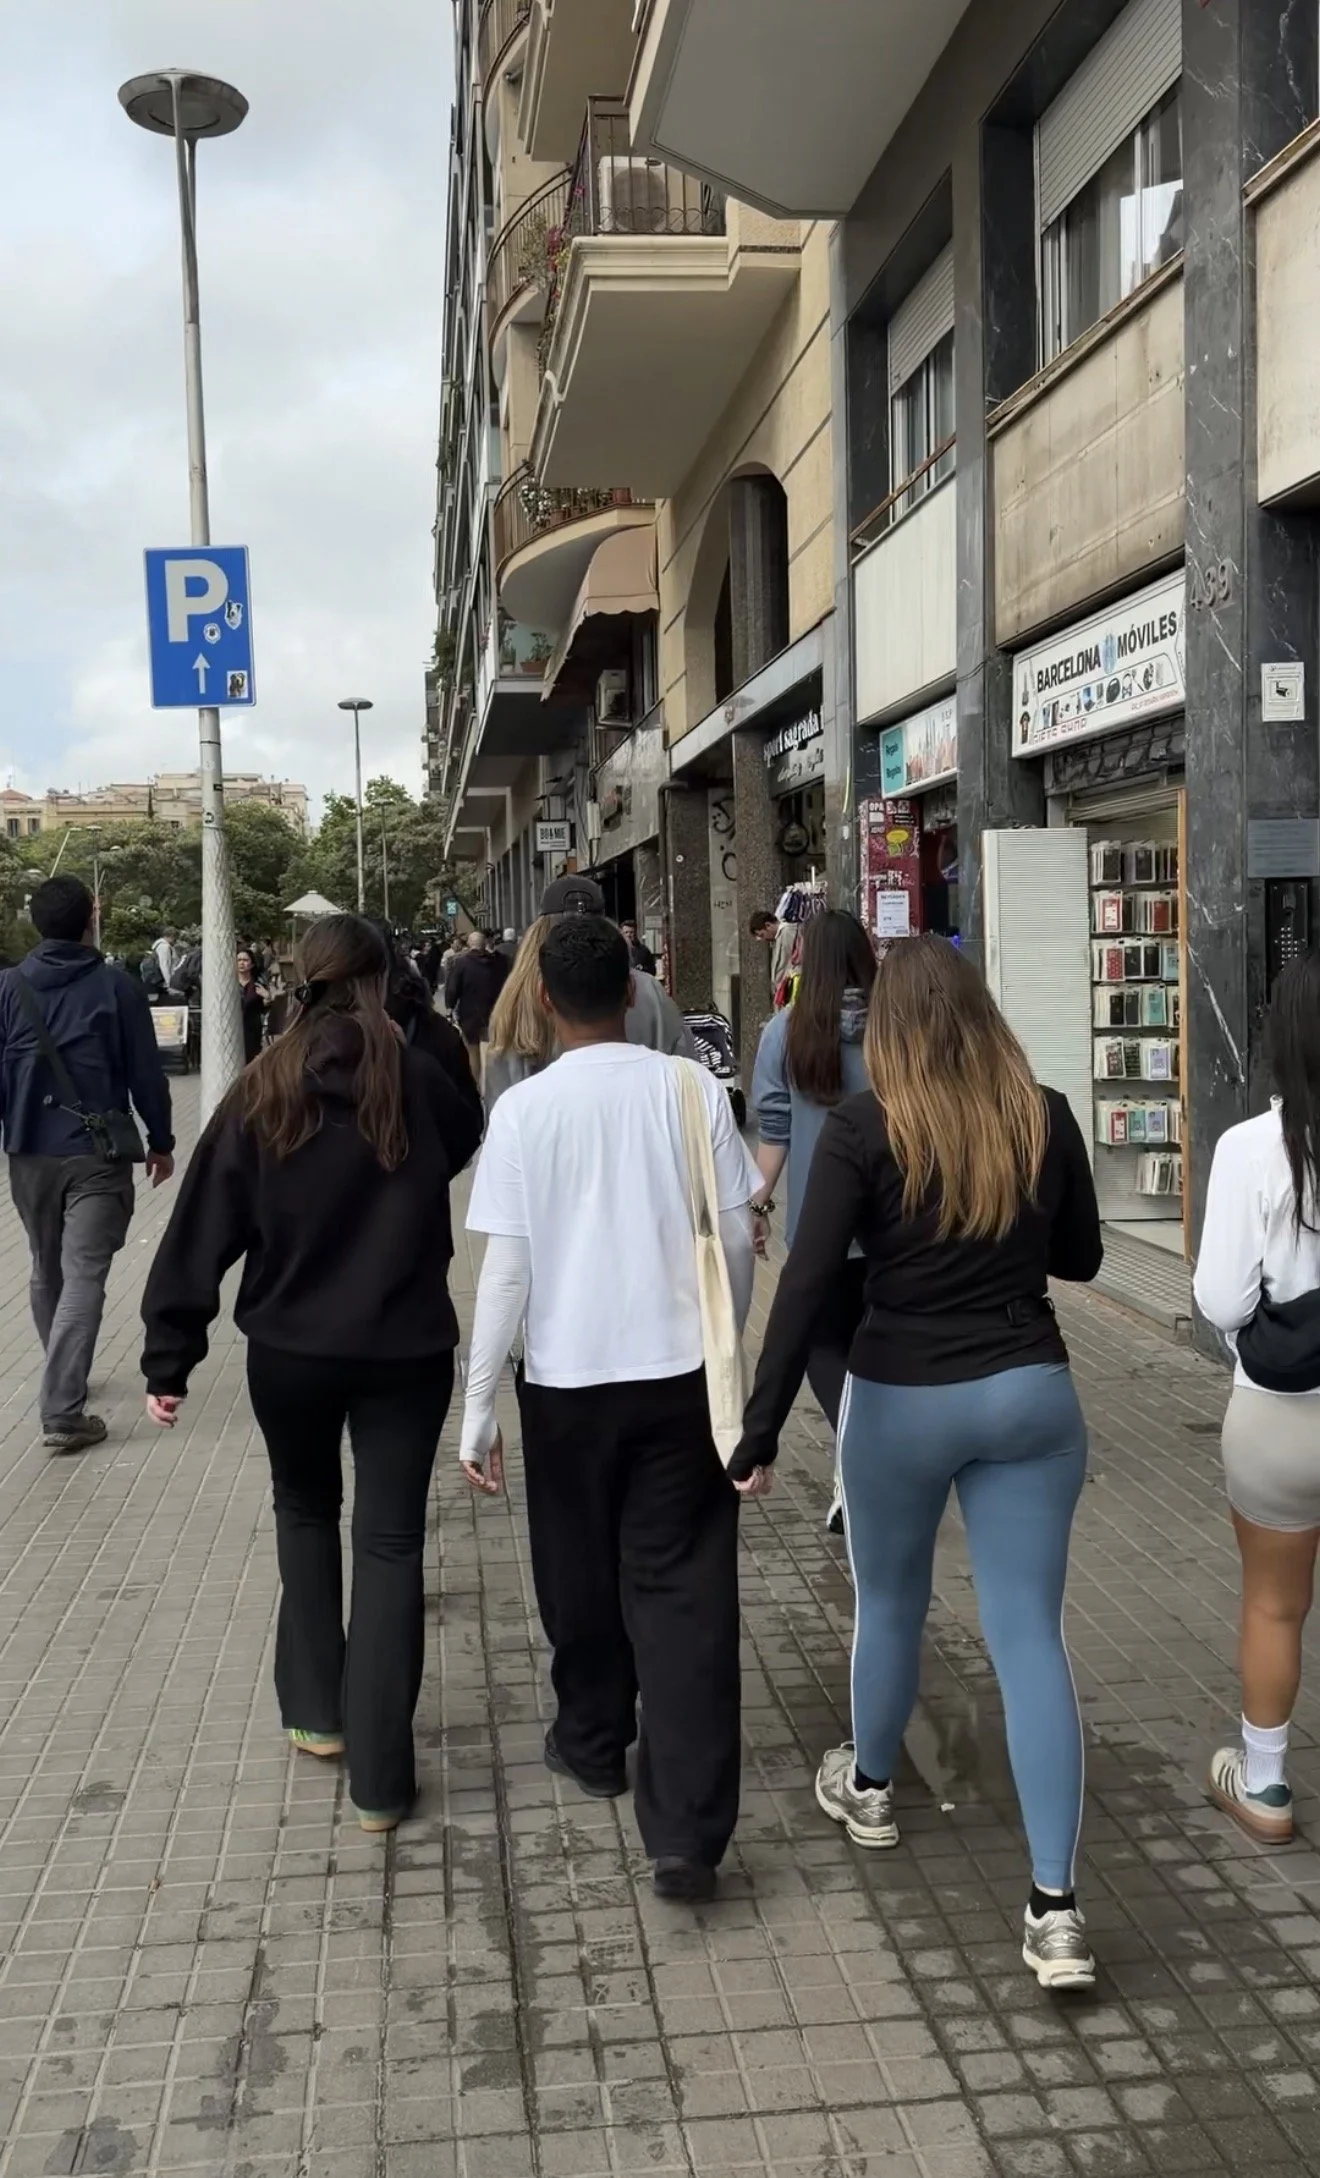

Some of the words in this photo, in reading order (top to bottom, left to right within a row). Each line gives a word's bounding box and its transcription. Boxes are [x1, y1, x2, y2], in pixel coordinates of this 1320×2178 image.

[165, 558, 229, 643] P
[1037, 644, 1101, 693] BARCELONA
[1117, 611, 1177, 659] MÓVILES
